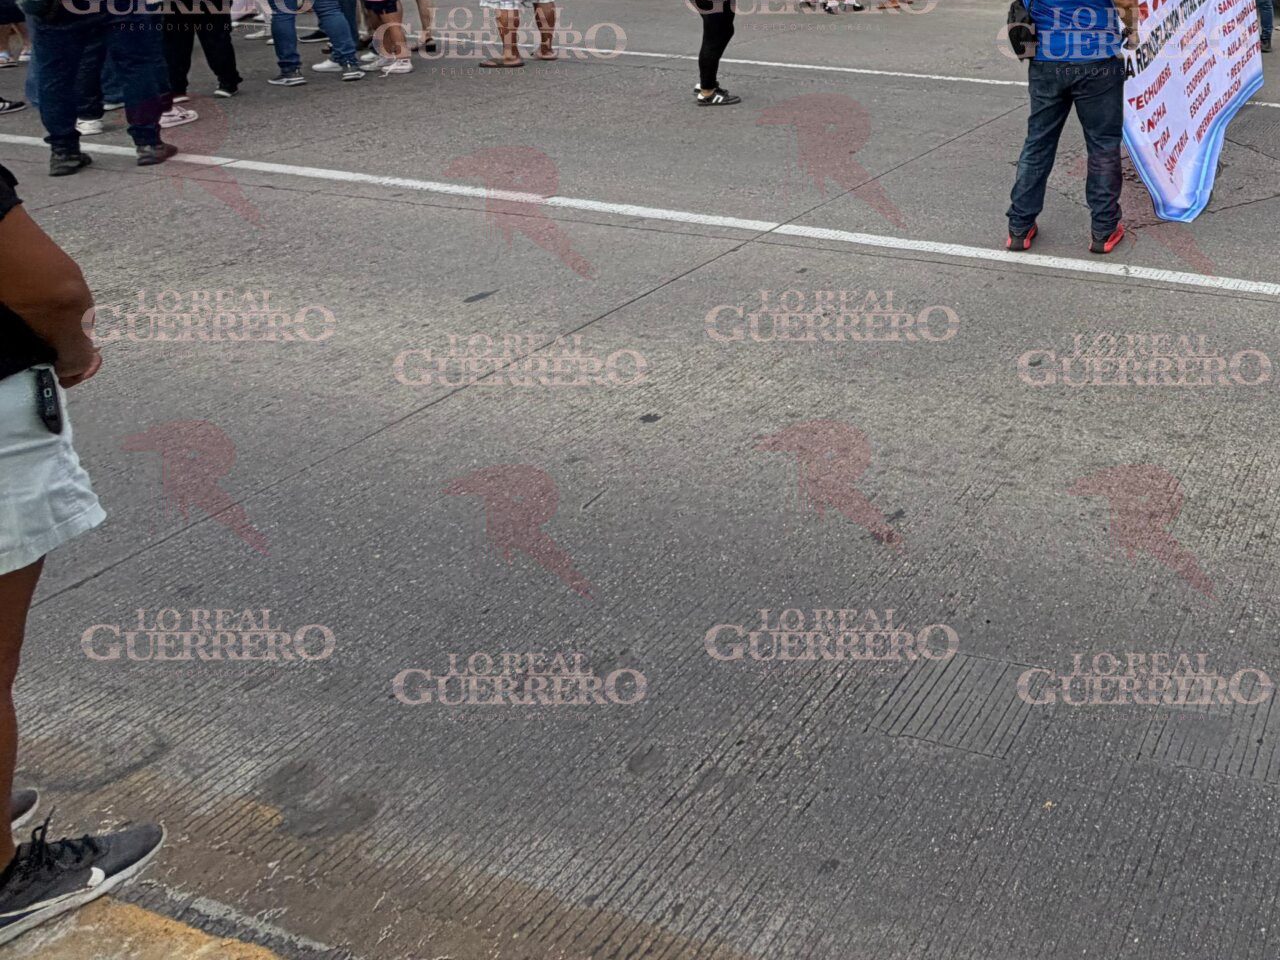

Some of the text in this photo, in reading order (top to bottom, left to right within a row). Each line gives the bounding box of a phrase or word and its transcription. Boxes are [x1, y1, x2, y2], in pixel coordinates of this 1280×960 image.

[1222, 20, 1236, 37] RED
[1226, 36, 1242, 60] AULA
[1186, 53, 1217, 98] COOPERATIVA
[1229, 60, 1242, 80] RED
[1189, 82, 1211, 119] ESCOLAR
[1164, 129, 1189, 175] SANITARIA
